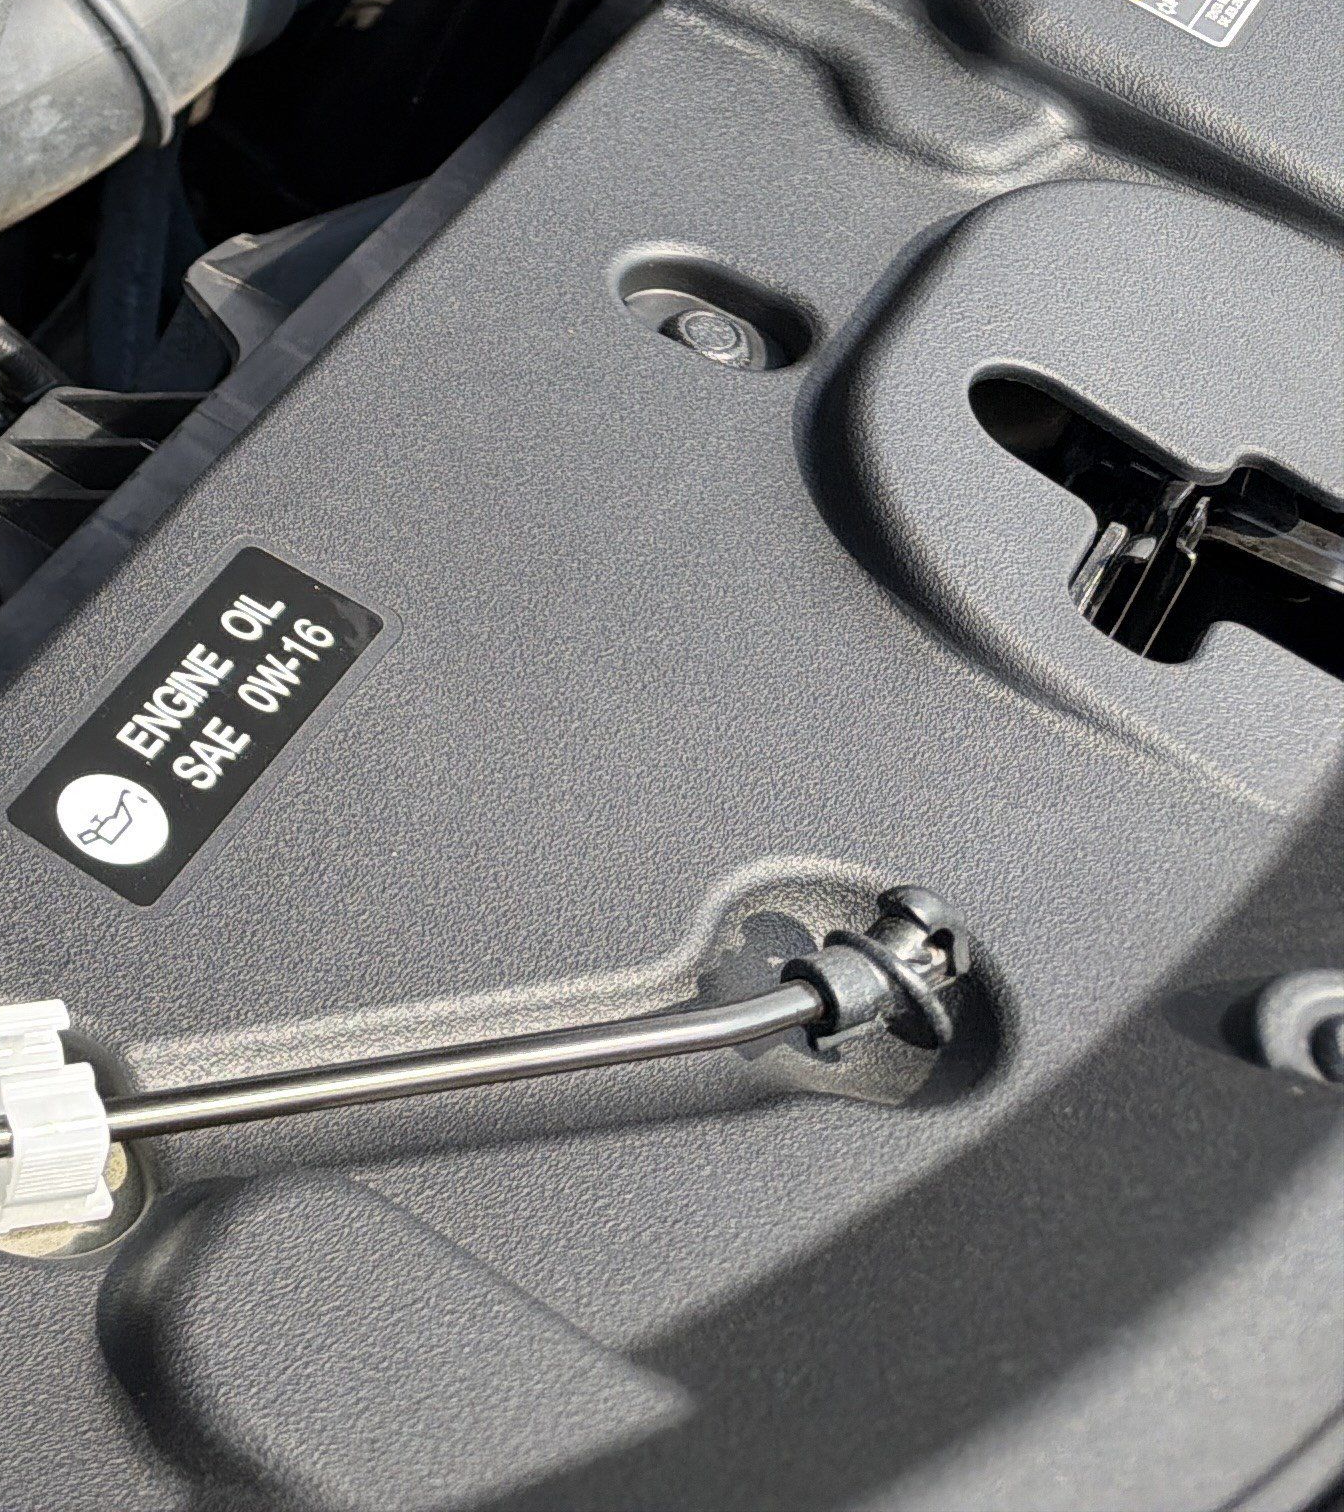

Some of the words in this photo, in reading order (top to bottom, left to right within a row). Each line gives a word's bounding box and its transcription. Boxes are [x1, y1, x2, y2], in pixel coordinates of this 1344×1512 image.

[116, 643, 235, 761] ENGINE
[220, 594, 286, 642] OIL
[172, 716, 252, 790] SAE
[237, 618, 336, 714] 0W-16
